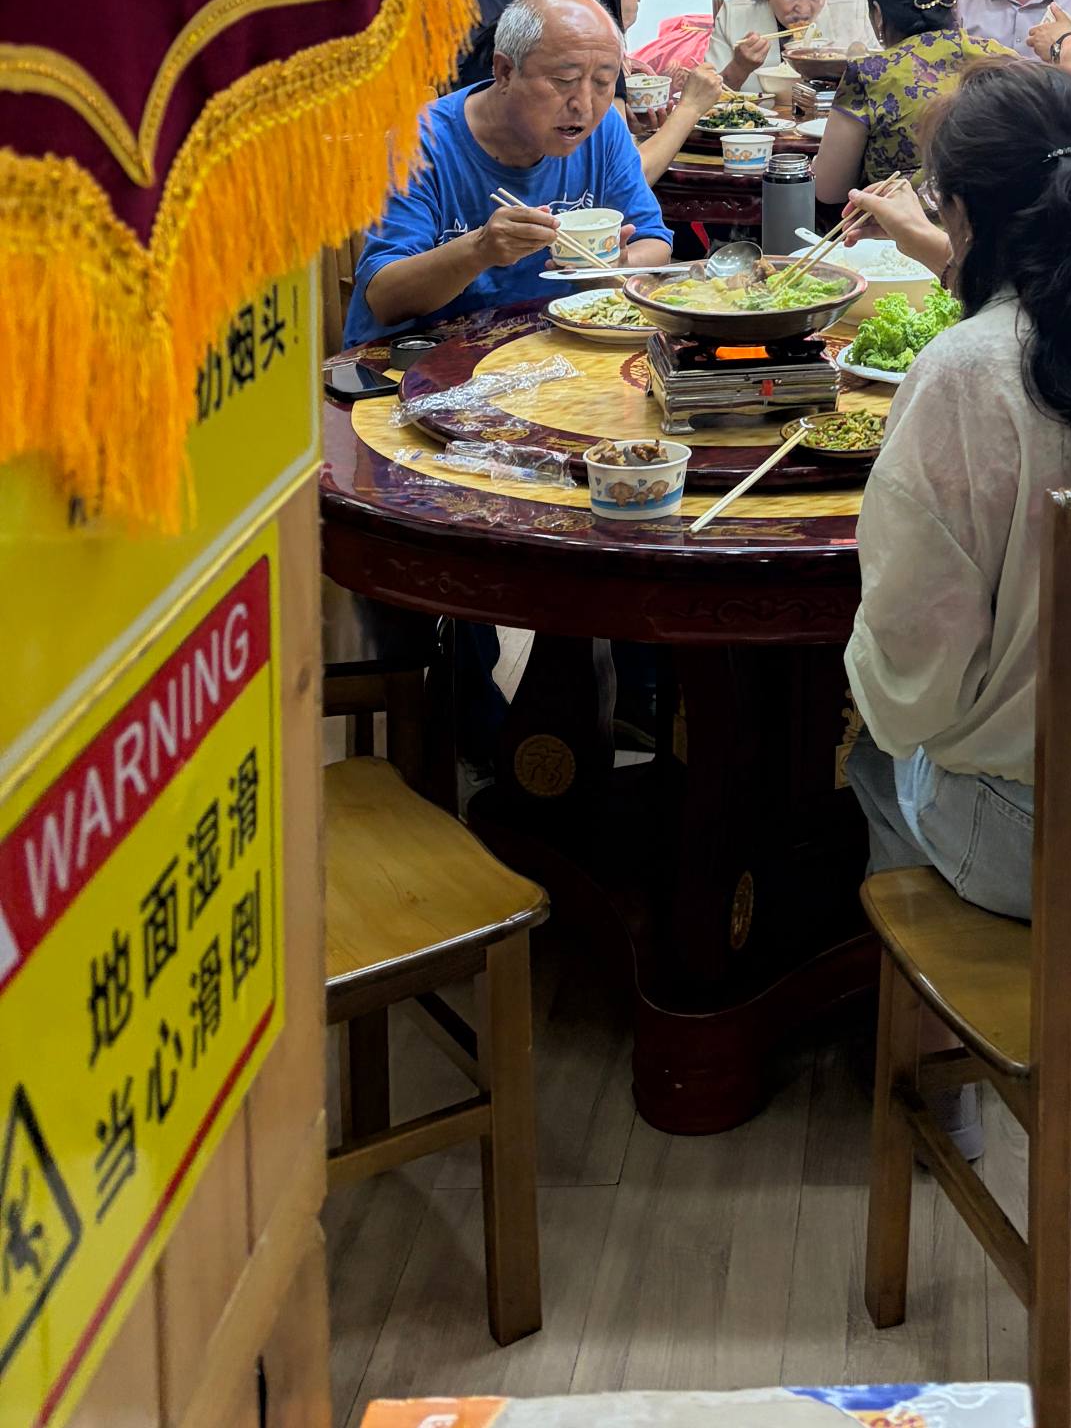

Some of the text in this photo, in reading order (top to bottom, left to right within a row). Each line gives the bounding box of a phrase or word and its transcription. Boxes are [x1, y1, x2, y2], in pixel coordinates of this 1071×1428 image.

[24, 602, 250, 920] WARNING
[88, 746, 259, 1070] 地面湿滑
[95, 870, 261, 1225] 当心滑倒
